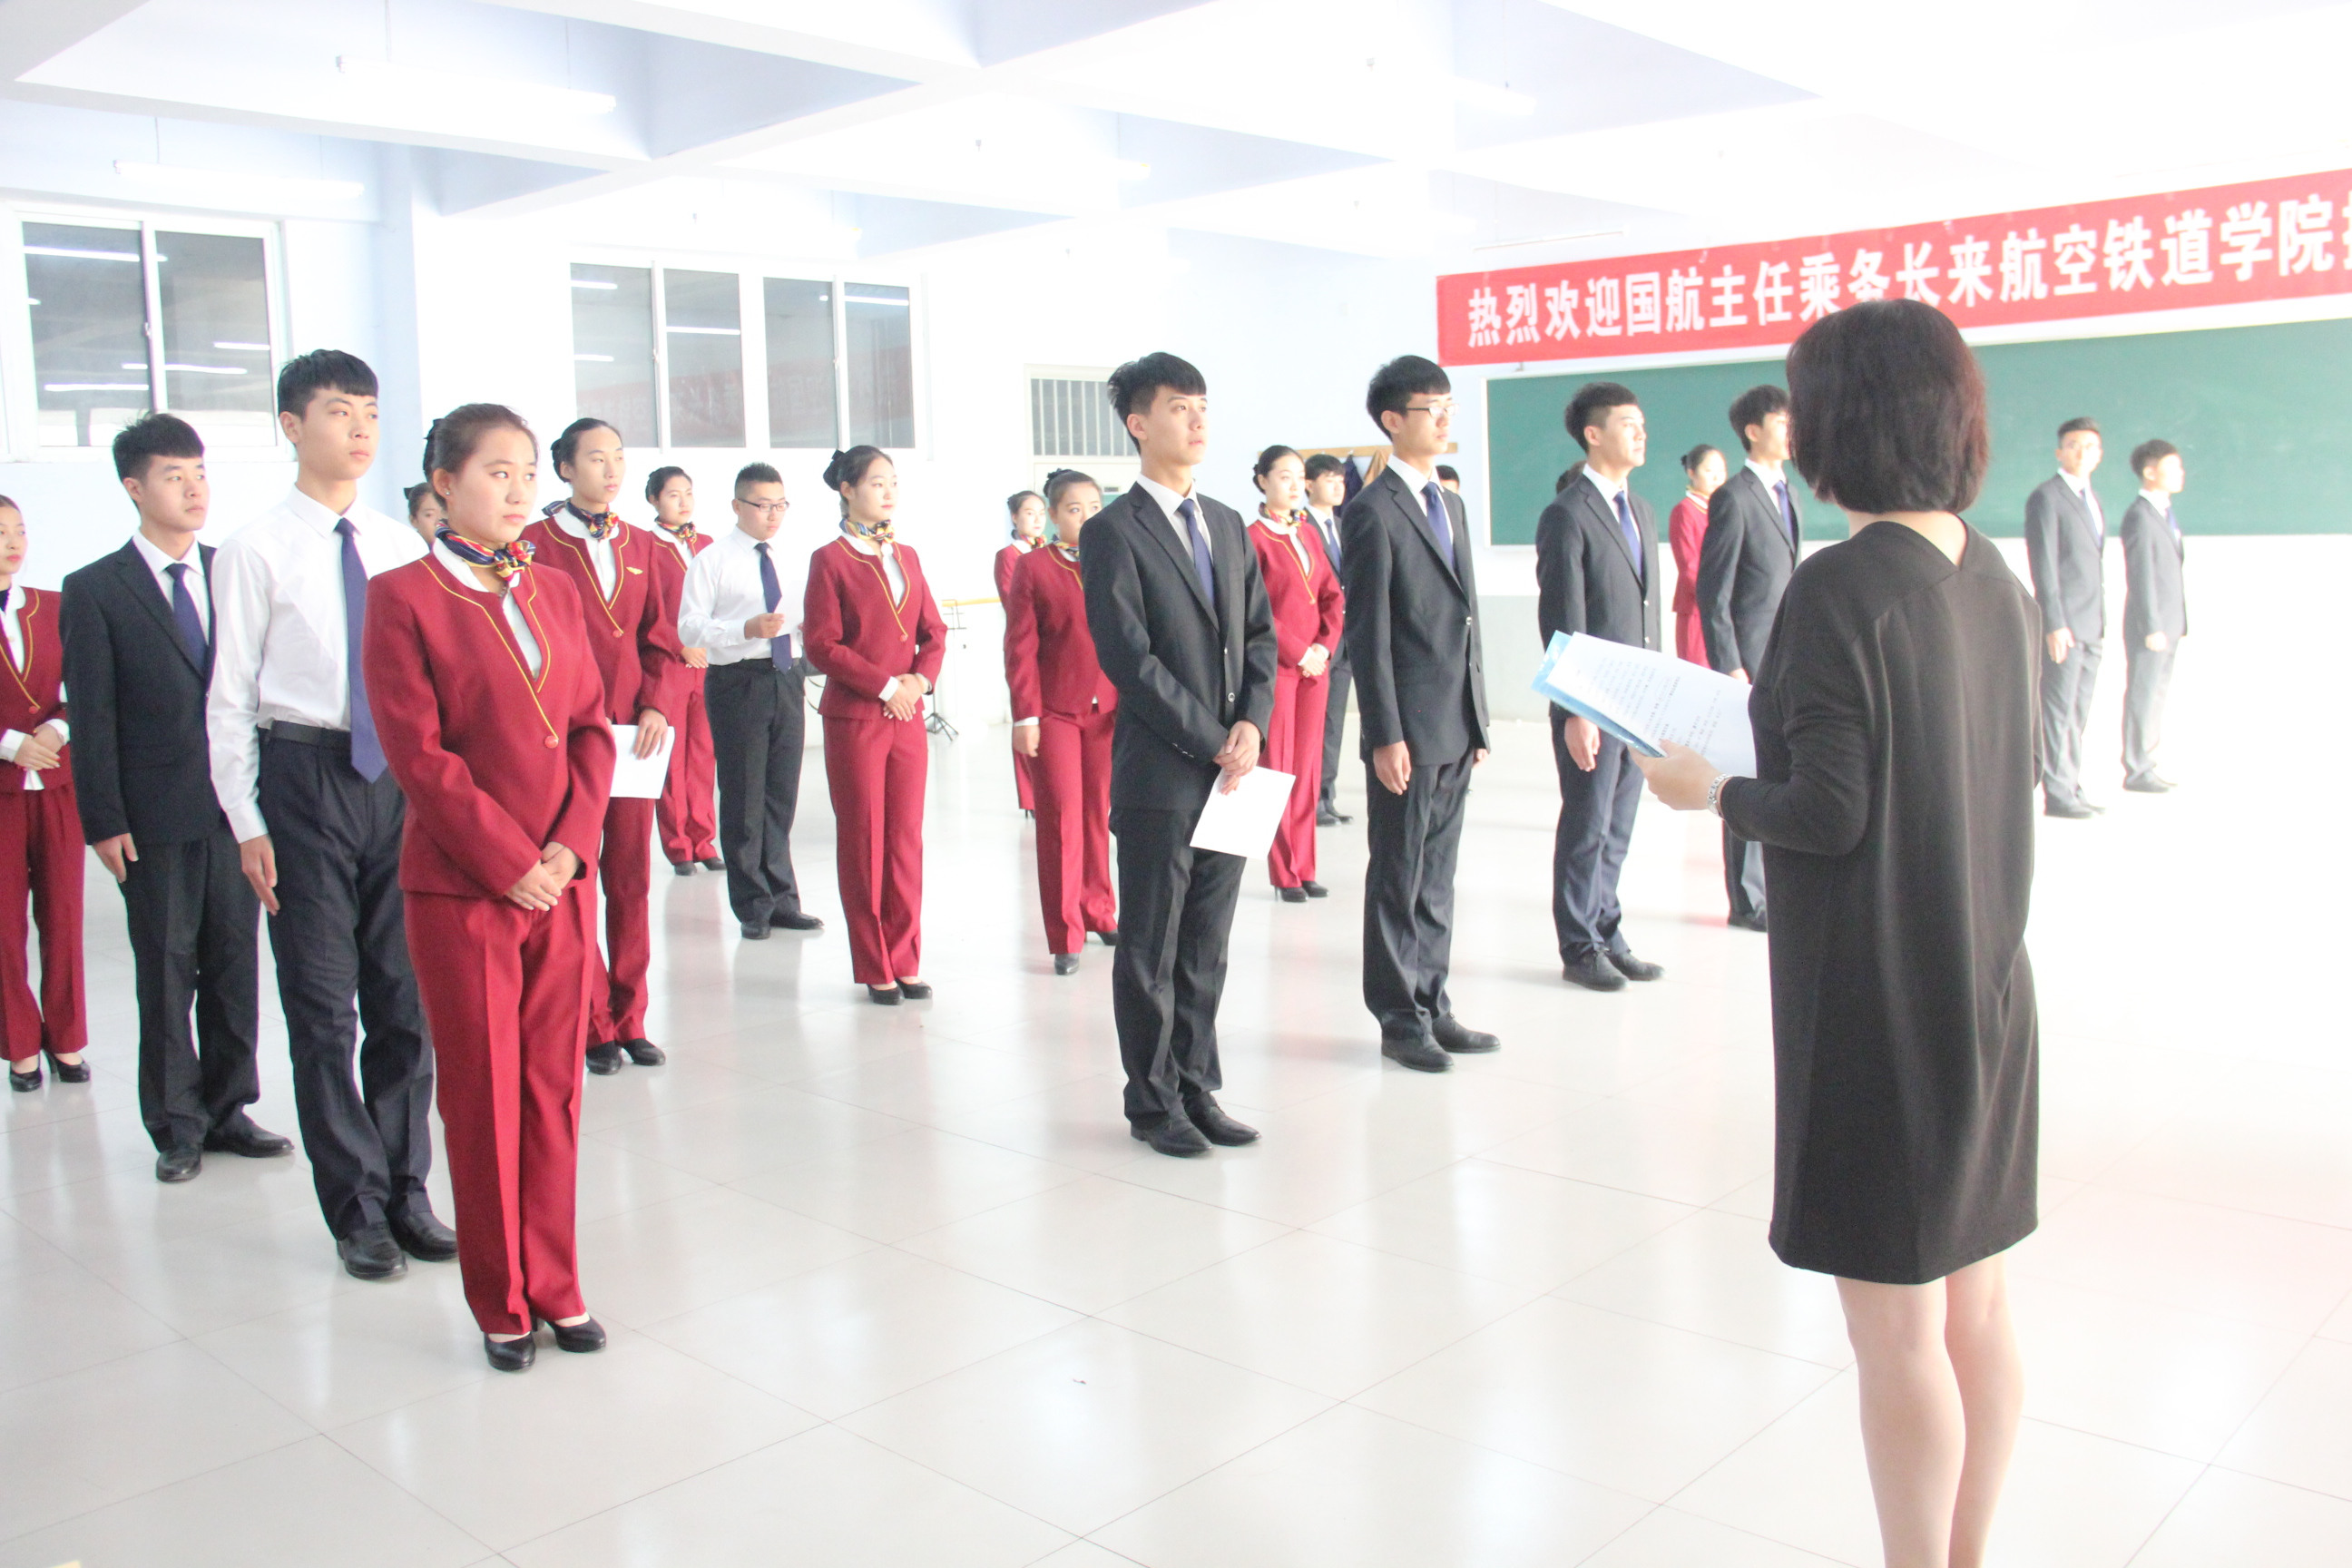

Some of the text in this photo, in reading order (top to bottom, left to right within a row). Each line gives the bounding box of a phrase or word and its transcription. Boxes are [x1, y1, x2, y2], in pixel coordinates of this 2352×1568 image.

[1467, 190, 2352, 348] 热烈欢迎国航主任乘务长来航空铁道学院
